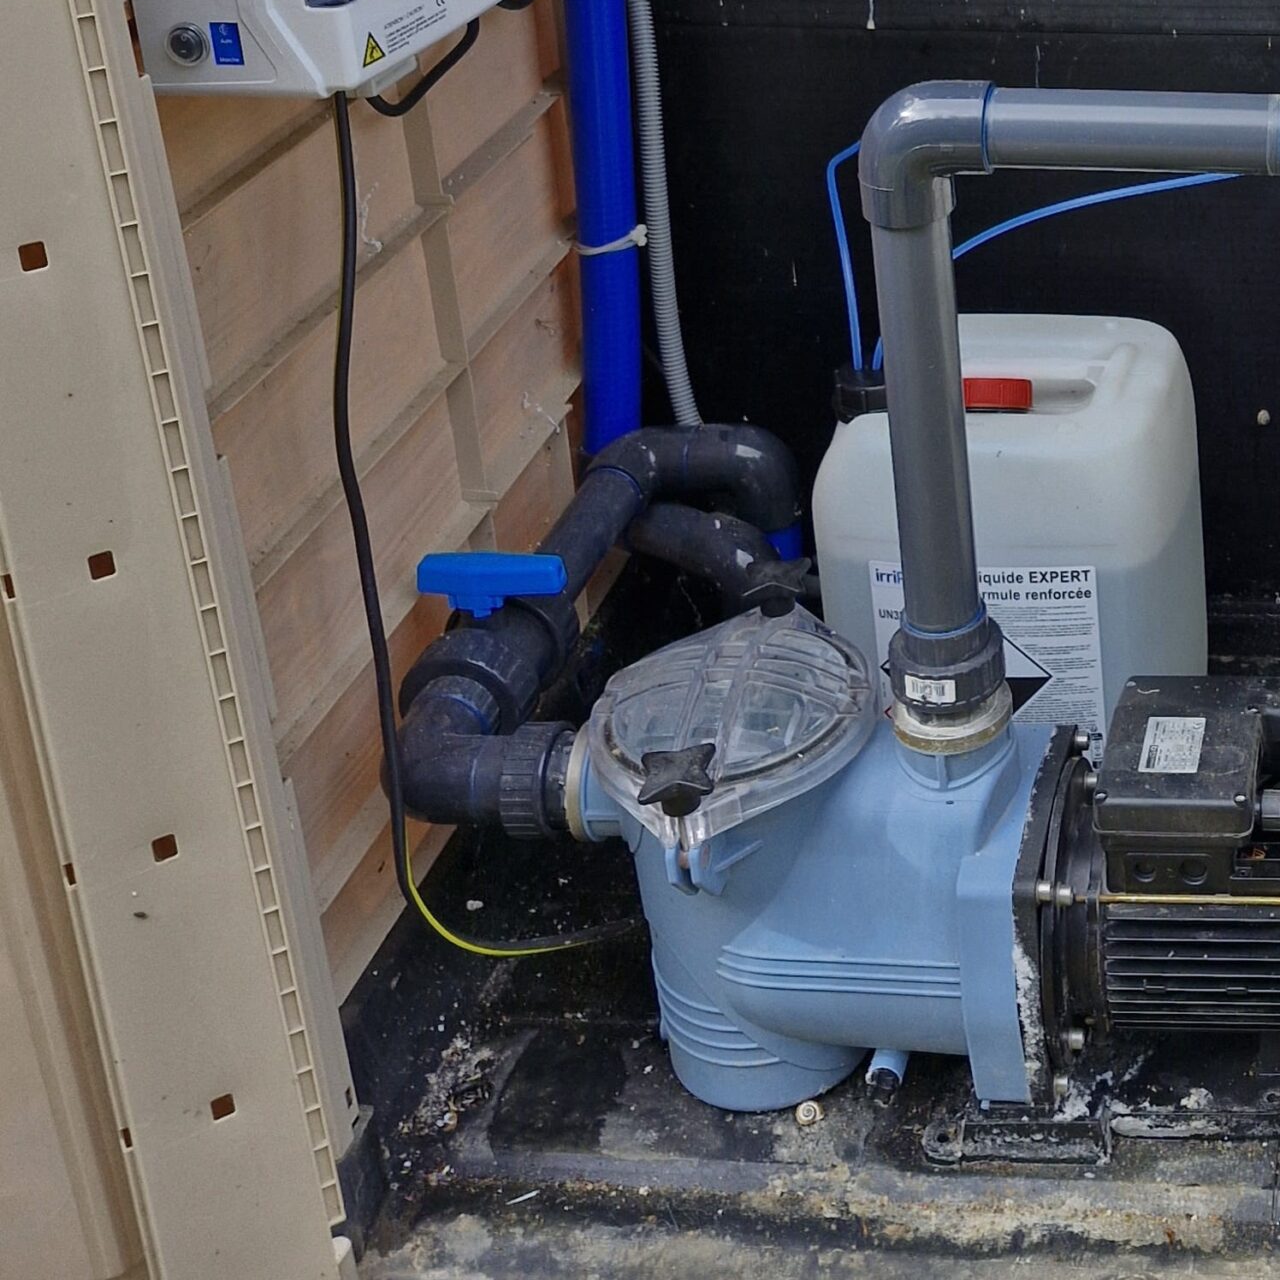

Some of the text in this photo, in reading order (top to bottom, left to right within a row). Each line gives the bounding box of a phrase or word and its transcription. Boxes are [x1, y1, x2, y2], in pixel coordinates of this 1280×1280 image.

[875, 568, 904, 584] irriP
[978, 569, 1091, 586] iquide EXPERT
[982, 587, 1092, 601] rmule renforcée
[879, 608, 902, 620] UN3
